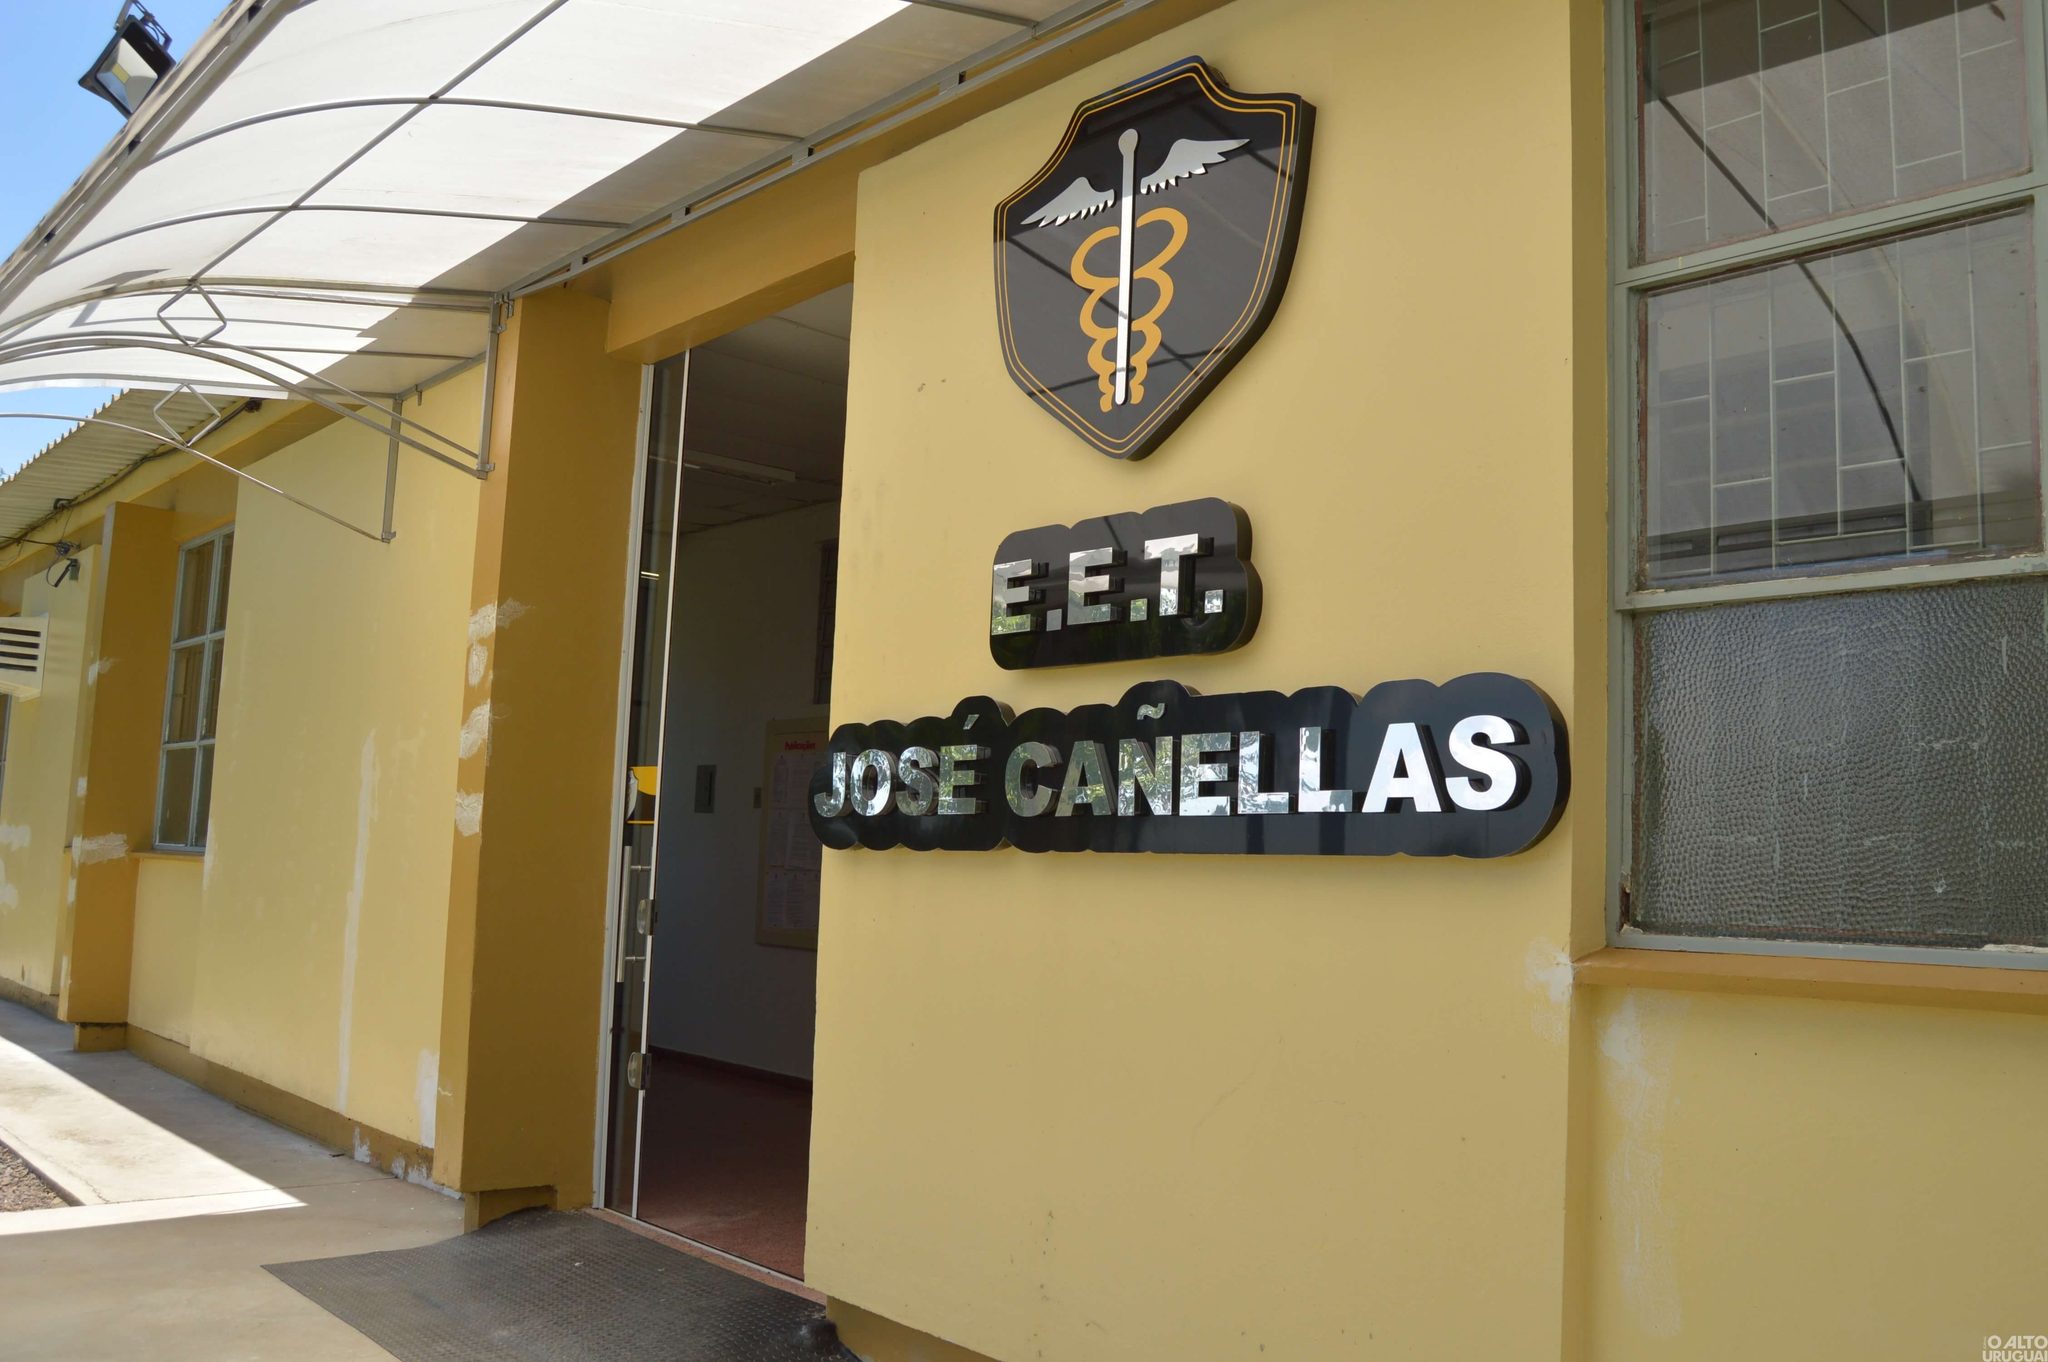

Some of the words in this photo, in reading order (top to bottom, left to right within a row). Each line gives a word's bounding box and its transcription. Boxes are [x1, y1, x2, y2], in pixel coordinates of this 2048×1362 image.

[992, 533, 1224, 636] E.E.T.
[814, 714, 978, 817] JOSÉ
[1005, 703, 1518, 817] CAÑELLAS
